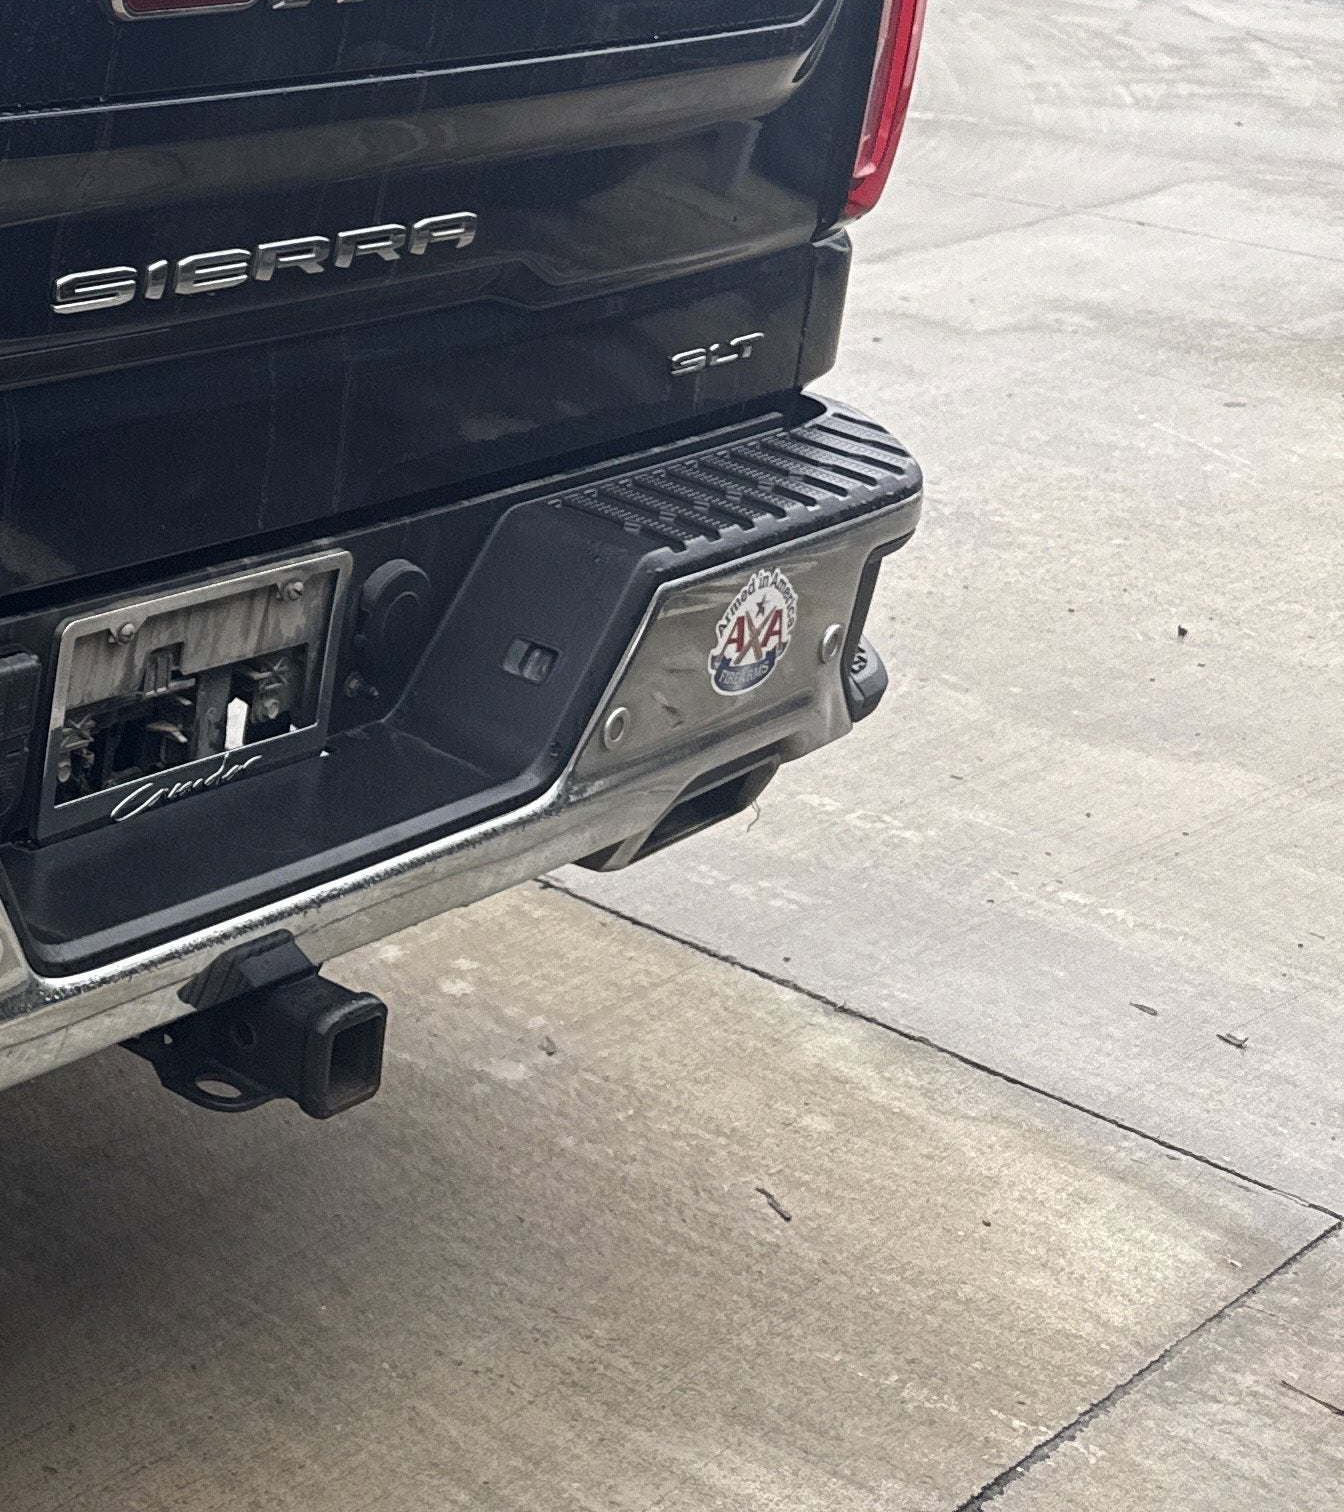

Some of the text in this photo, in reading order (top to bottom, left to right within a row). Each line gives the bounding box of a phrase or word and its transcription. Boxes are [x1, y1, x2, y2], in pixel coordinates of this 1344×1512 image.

[51, 211, 479, 314] SIERRA
[671, 332, 765, 377] SLT
[718, 577, 756, 638] Armed
[758, 572, 770, 589] in
